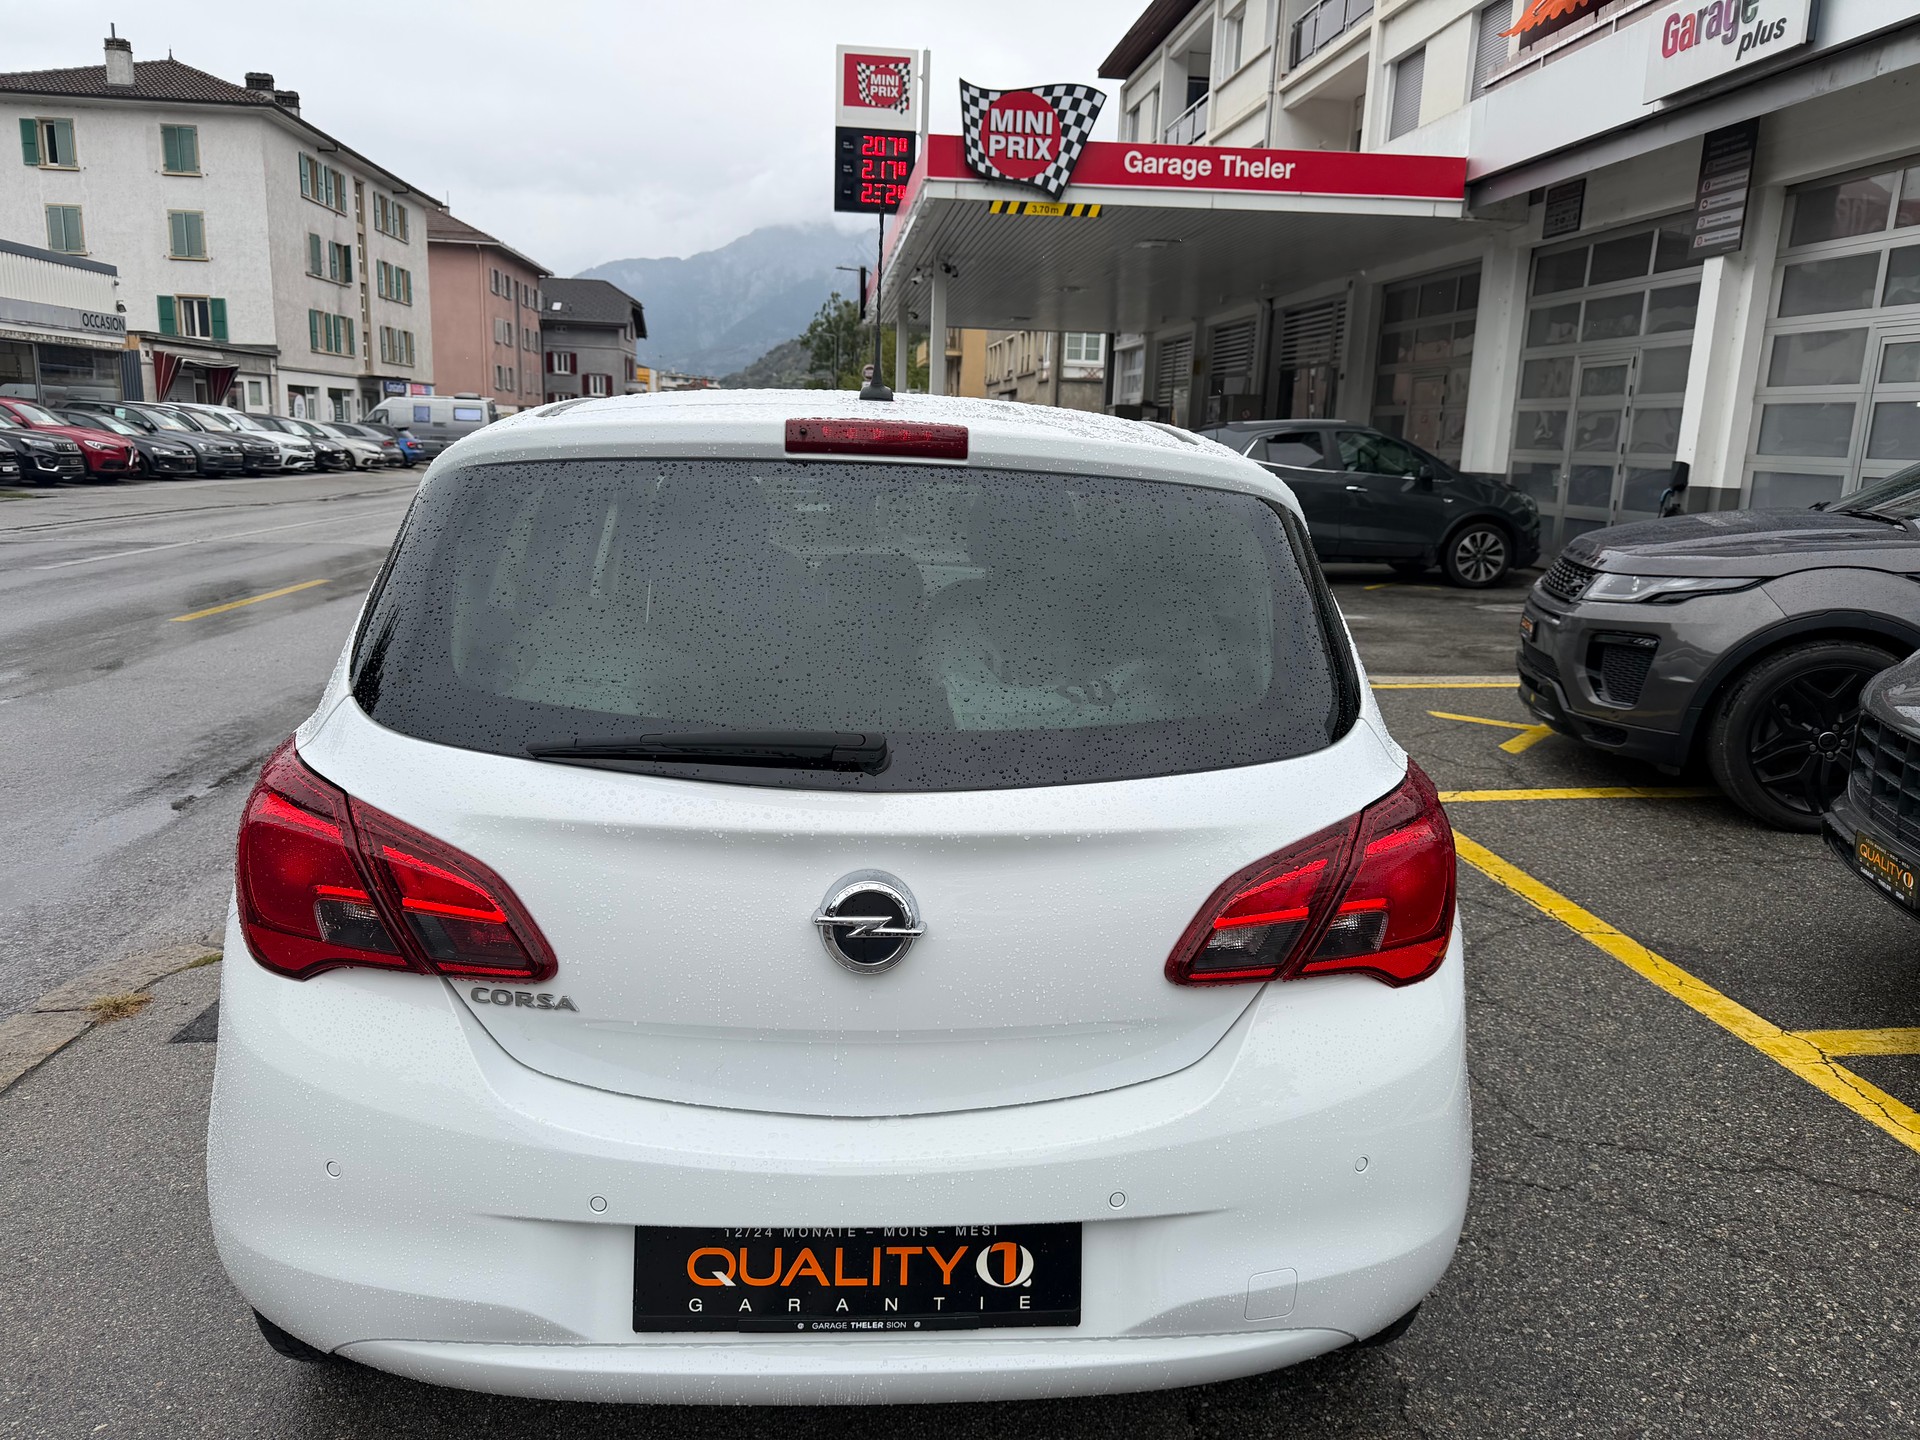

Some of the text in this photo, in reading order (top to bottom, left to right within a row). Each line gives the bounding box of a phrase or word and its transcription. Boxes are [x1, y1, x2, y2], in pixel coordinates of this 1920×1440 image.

[1661, 0, 1760, 59] Garage
[1735, 17, 1787, 61] plus
[869, 85, 900, 98] PRIX
[870, 74, 899, 86] MINI
[989, 107, 1054, 135] MINI
[988, 134, 1052, 161] PRIX
[1123, 150, 1296, 181] Garage Theler
[82, 312, 126, 332] OCCASION
[1859, 843, 1903, 880] QUALITY
[470, 986, 580, 1012] CORSA
[884, 1226, 928, 1237] MOIS
[955, 1226, 998, 1237] MESI
[686, 1245, 969, 1287] QUALITY
[688, 1295, 1032, 1313] GARANTIE
[812, 1321, 907, 1330] GARAGE THELER SION
